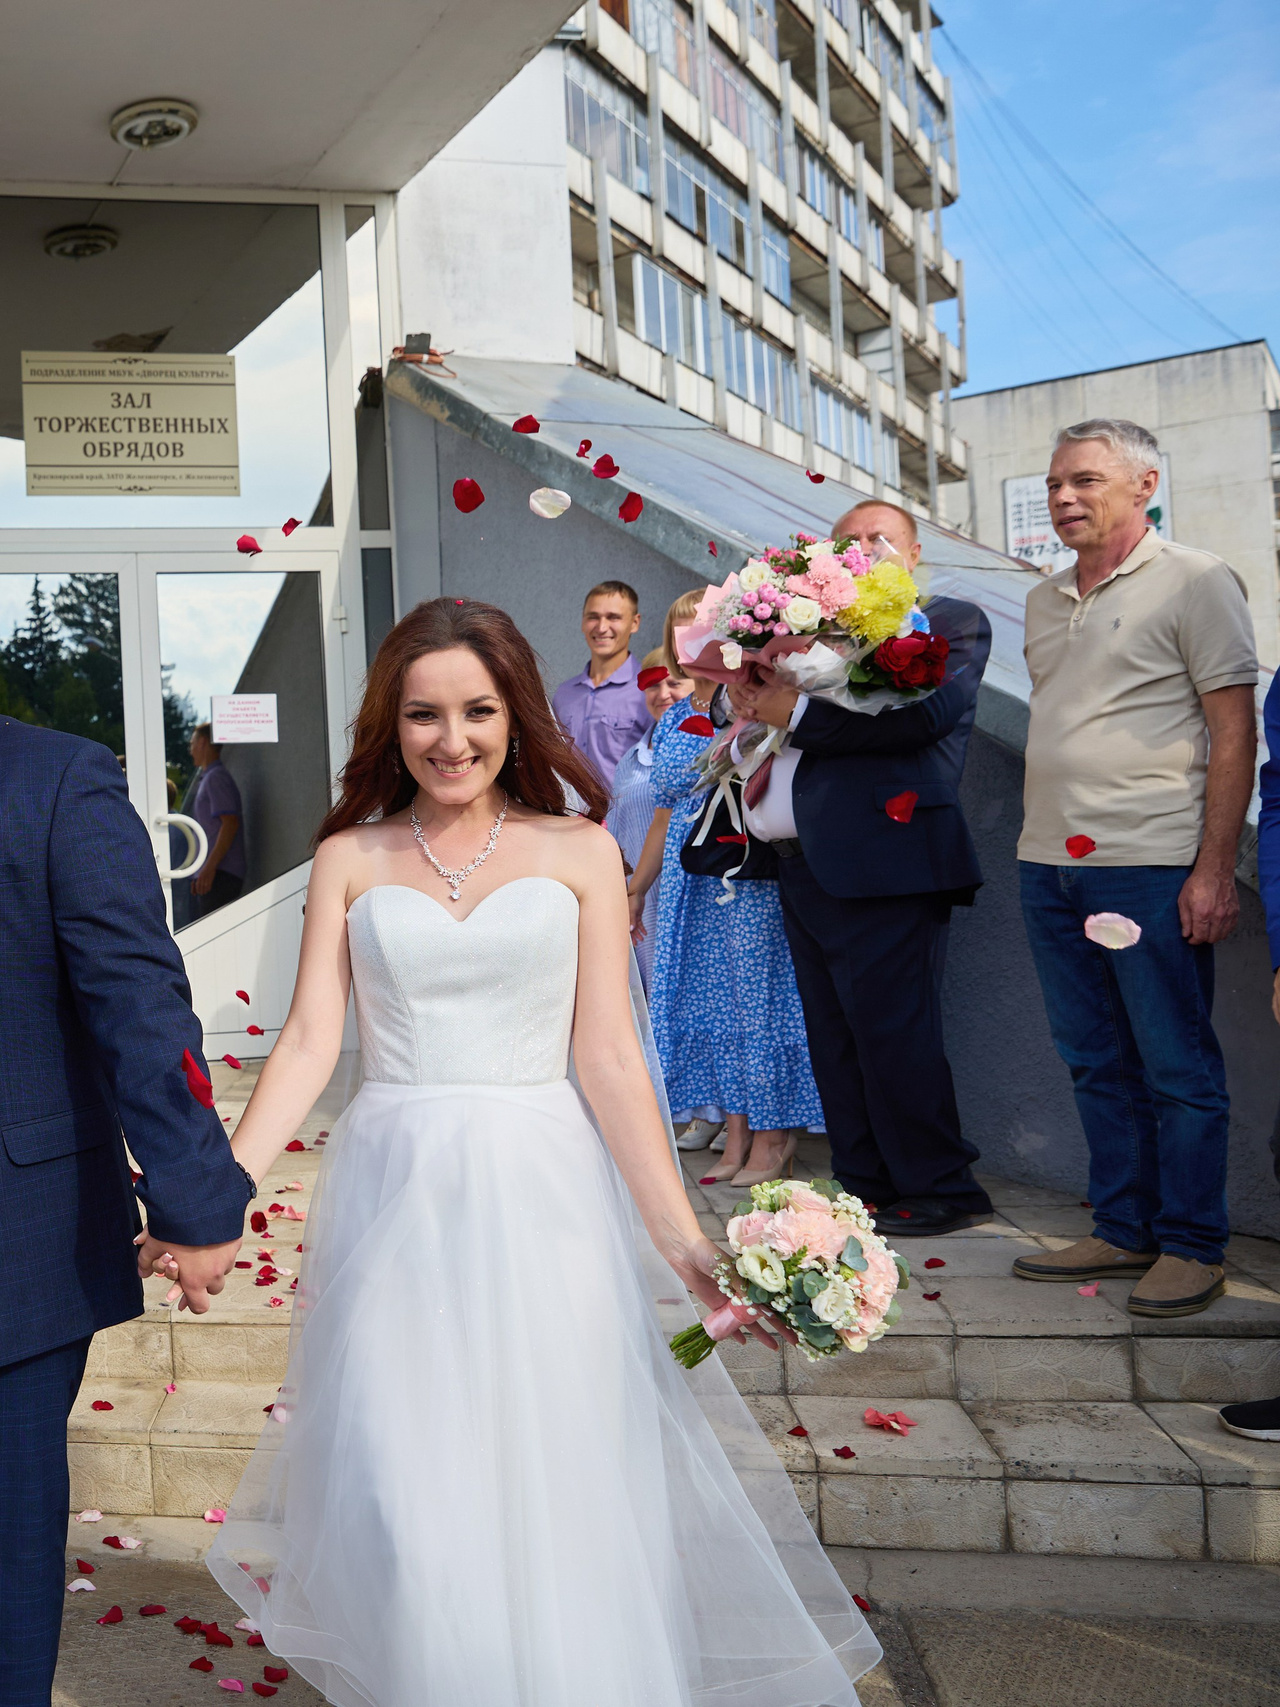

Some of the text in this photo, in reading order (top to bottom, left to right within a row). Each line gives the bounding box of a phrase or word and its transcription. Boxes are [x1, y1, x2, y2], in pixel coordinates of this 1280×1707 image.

[29, 368, 229, 379] ПОДРАЗДЕЛЕНИЕ МБУК «ДВОРЕЦ КУЛЬТУРЫ»
[110, 392, 152, 409] ЗАЛ
[33, 416, 229, 434] ТОРЖЕСТВЕННЫХ
[82, 441, 185, 461] ОБРЯДОВ
